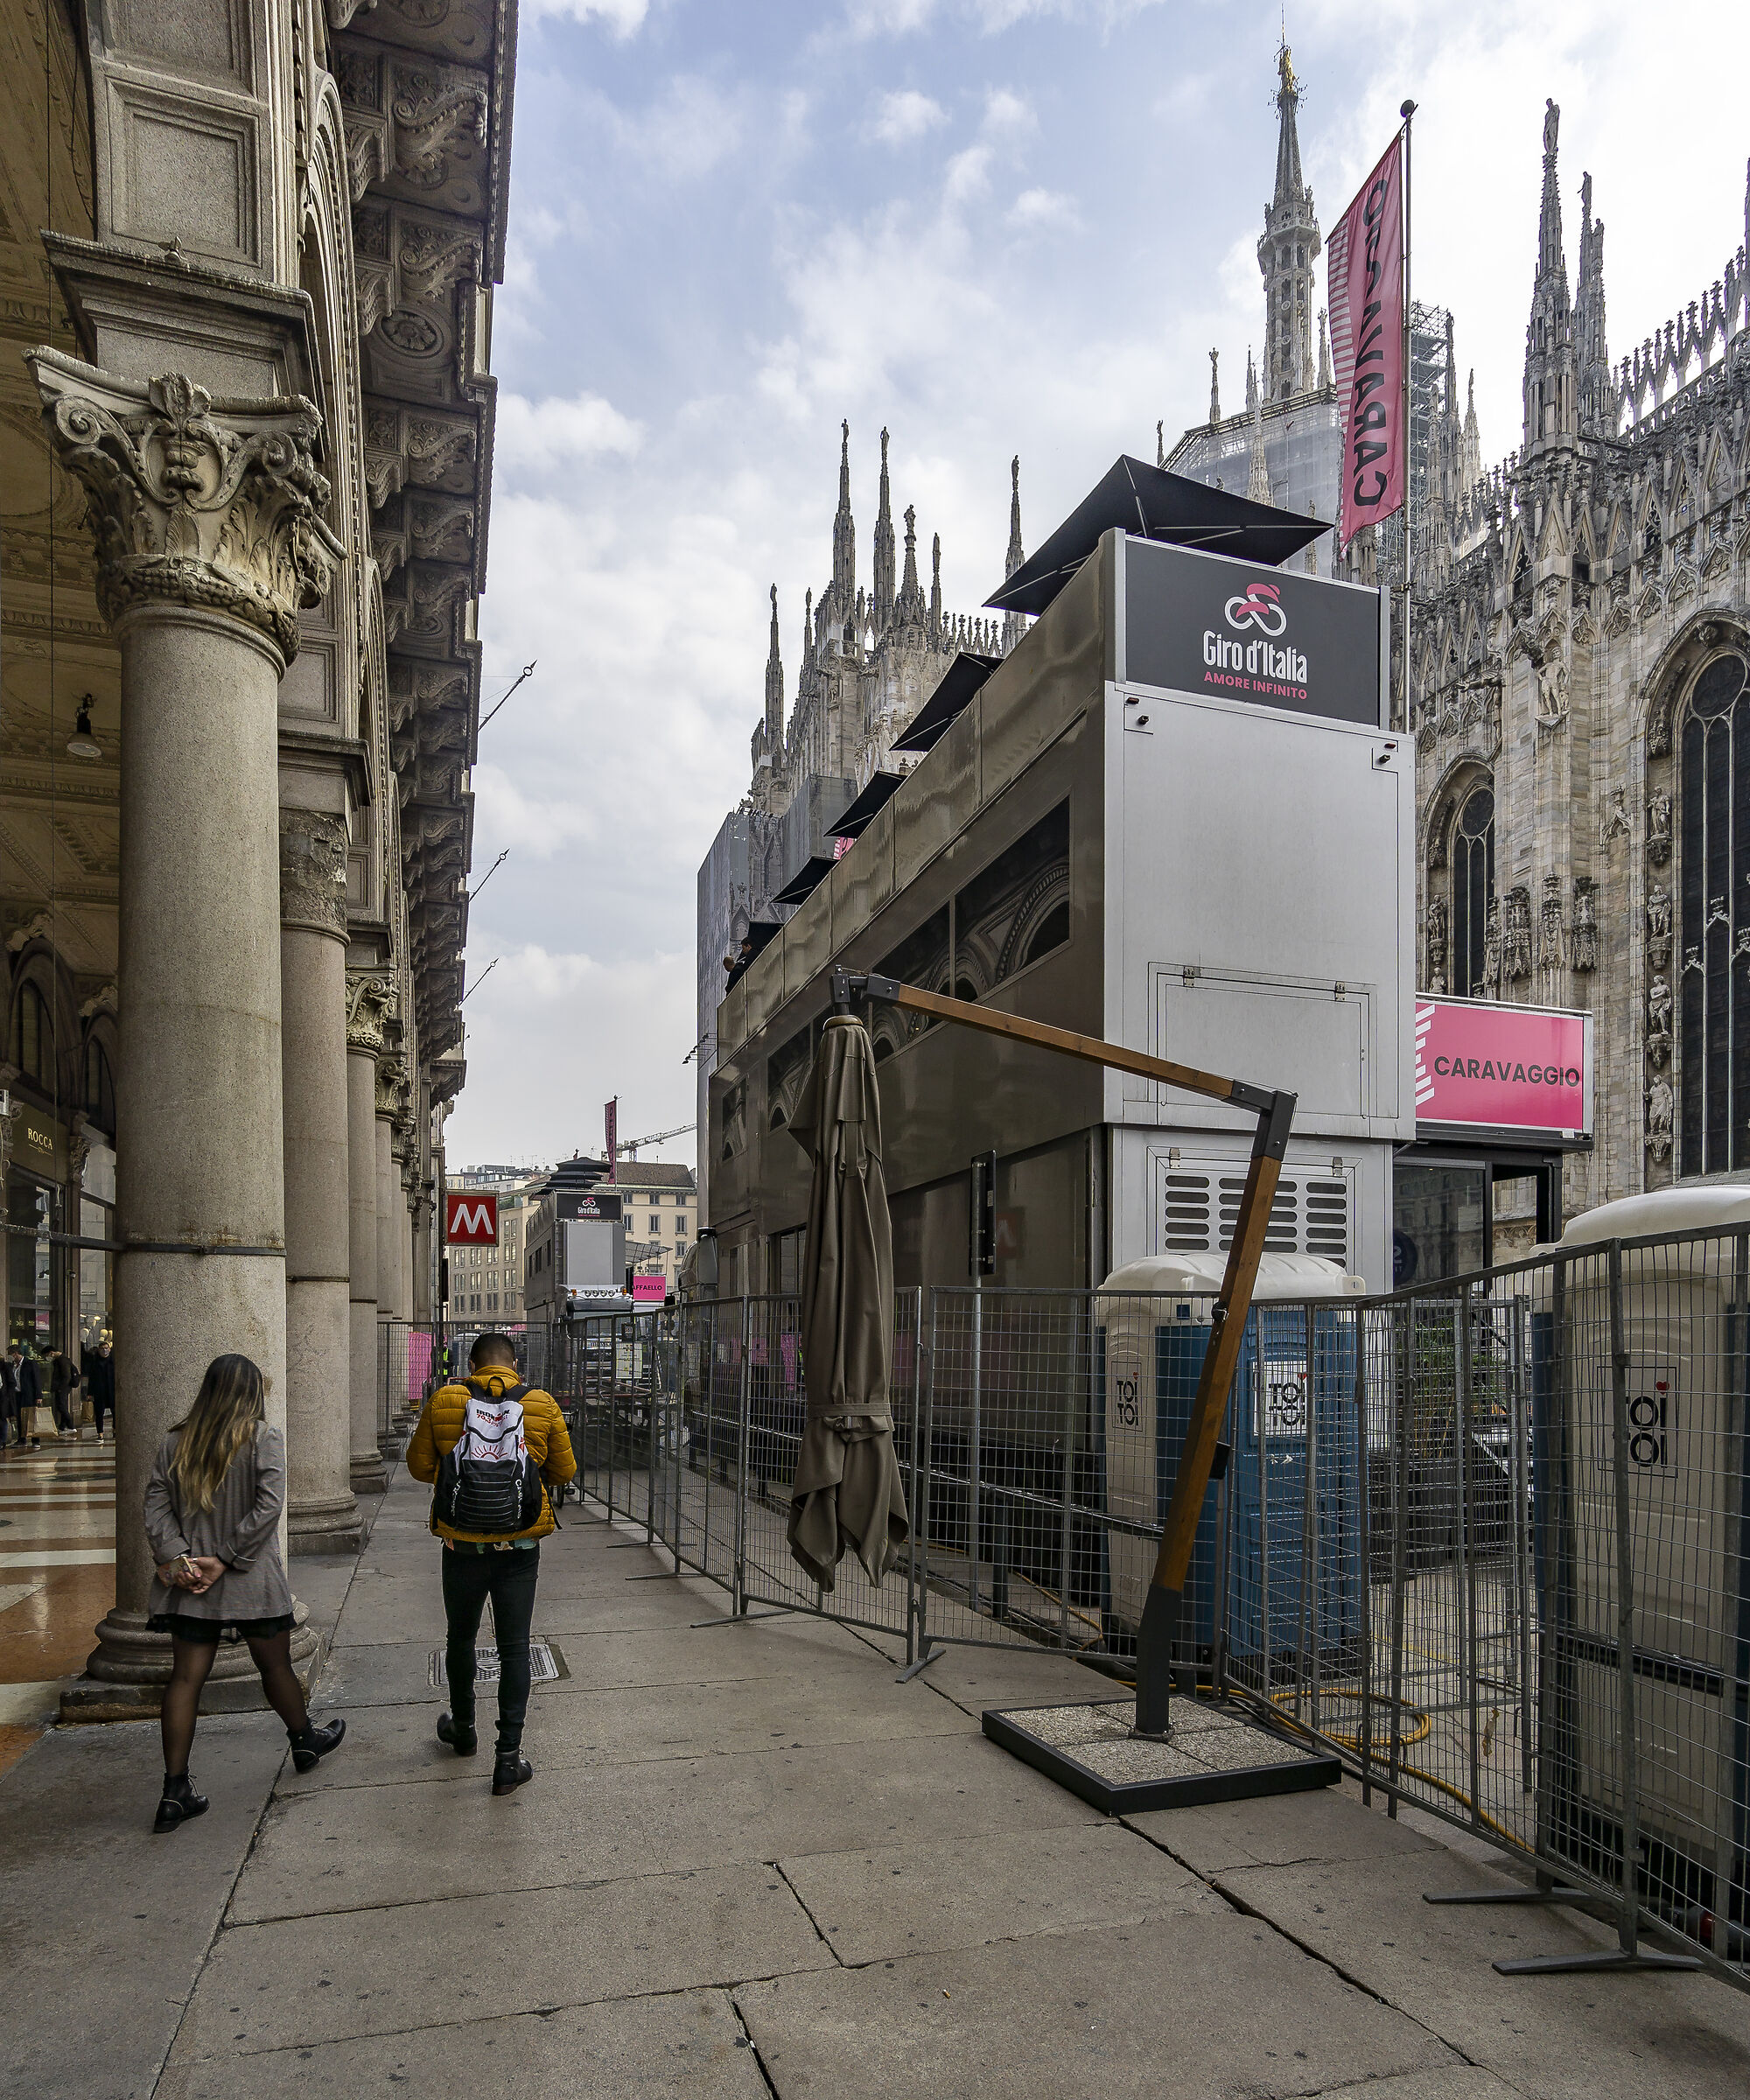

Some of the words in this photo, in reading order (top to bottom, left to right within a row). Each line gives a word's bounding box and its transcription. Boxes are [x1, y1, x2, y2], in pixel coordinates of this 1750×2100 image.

[1203, 630, 1242, 671] Giro
[1246, 640, 1307, 683] d'Italia
[1203, 672, 1250, 690] AMORE
[1253, 680, 1307, 700] INFINITO
[1434, 1055, 1580, 1088] CARAVAGGIO
[27, 1127, 52, 1151] ROCCA
[450, 1203, 494, 1235] M
[1626, 1396, 1667, 1432] OI
[1613, 1432, 1668, 1468] OI
